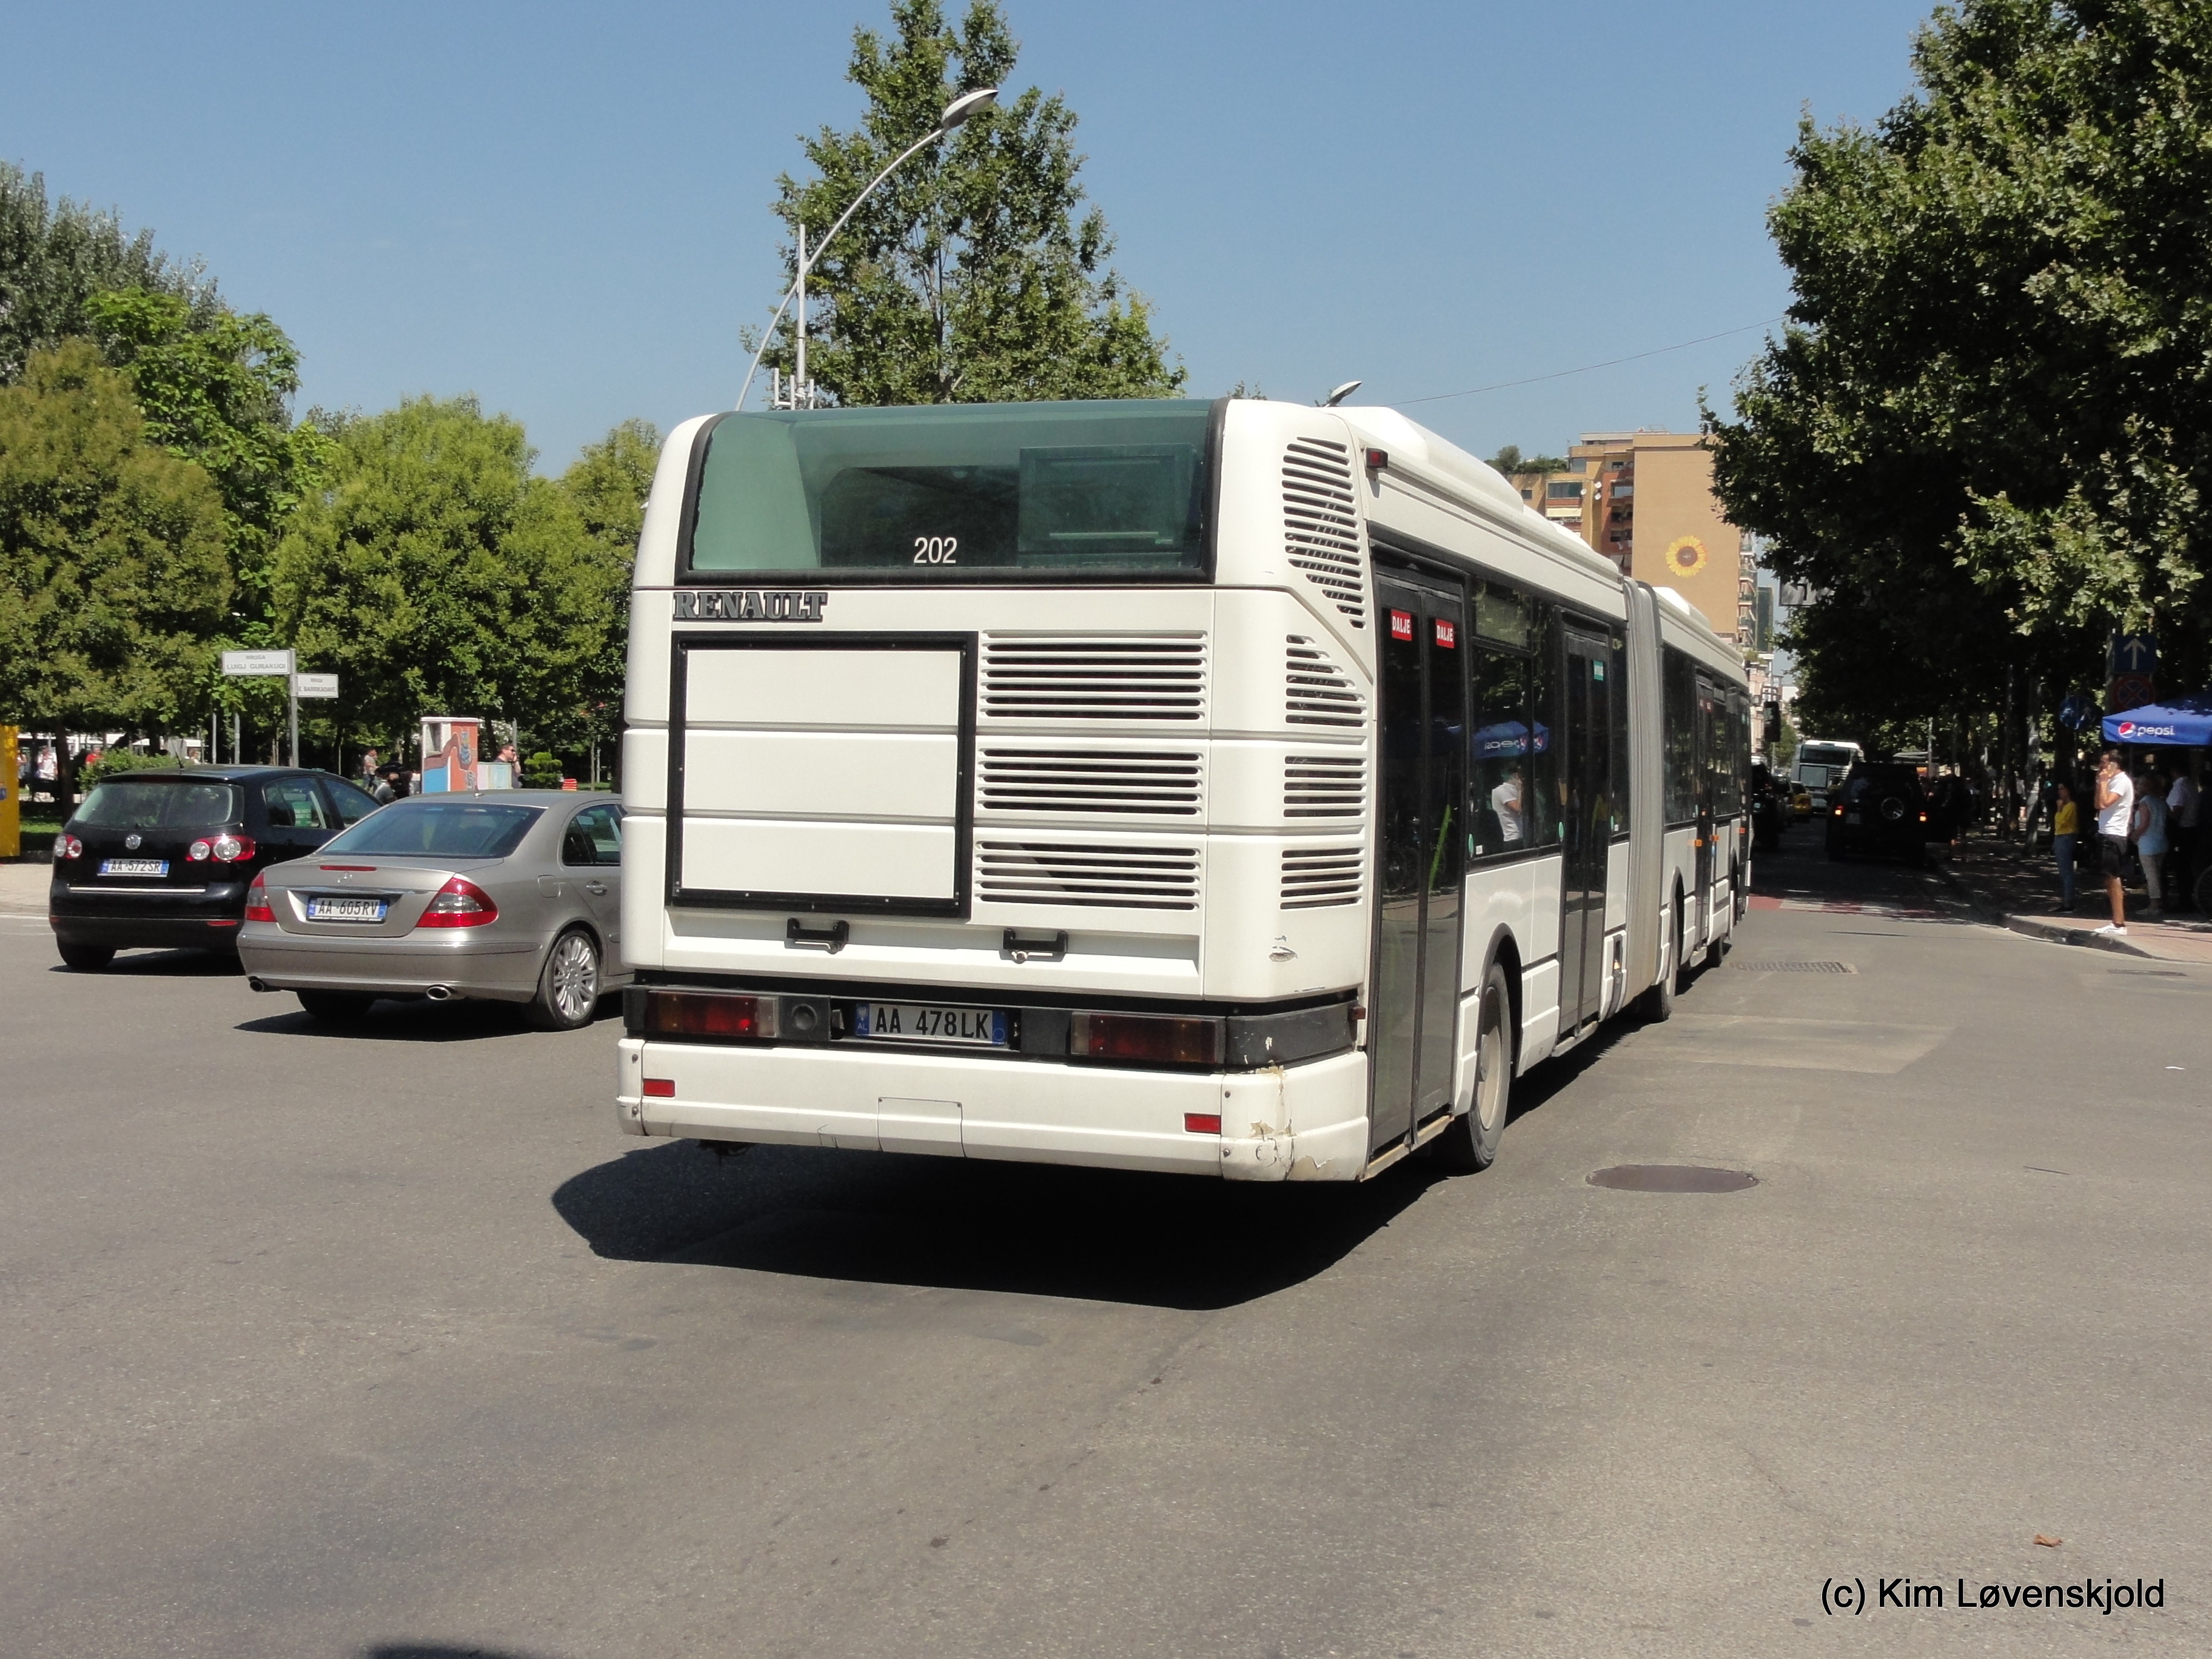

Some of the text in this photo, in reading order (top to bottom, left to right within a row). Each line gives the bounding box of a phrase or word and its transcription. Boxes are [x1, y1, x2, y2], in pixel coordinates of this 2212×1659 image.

[914, 537, 957, 564] 202
[673, 592, 828, 623] RENAULT
[1392, 615, 1410, 634] DALJE
[1436, 625, 1453, 642] DALJE
[2137, 725, 2175, 737] pepsi
[111, 860, 161, 872] AA 572SR
[318, 900, 378, 916] AA 605RV
[876, 1007, 989, 1039] AA 478LK
